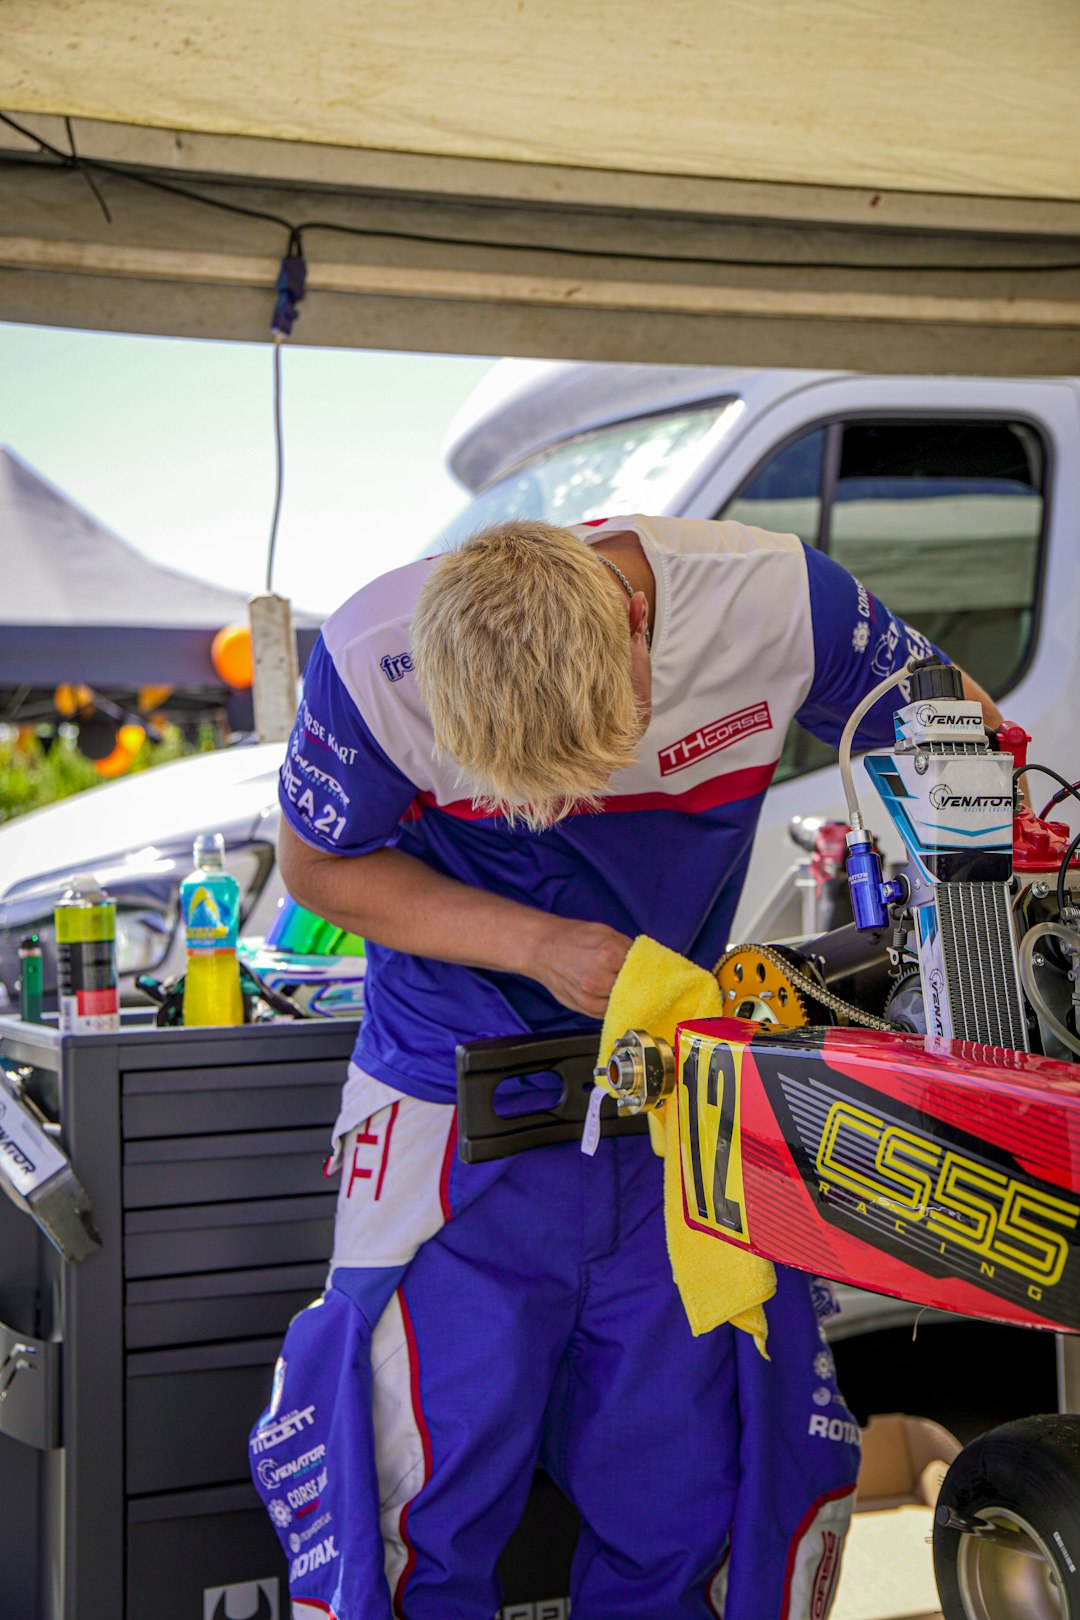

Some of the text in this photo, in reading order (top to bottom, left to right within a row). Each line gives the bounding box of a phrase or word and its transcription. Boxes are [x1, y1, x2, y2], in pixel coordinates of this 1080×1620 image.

[383, 655, 413, 680] fre
[927, 715, 982, 725] VENATO
[314, 803, 347, 840] 21
[682, 1039, 744, 1235] 12
[818, 1181, 1043, 1301] RACING
[808, 1413, 861, 1448] ROTA
[269, 1444, 326, 1483] VENATOR
[287, 1480, 319, 1509] CORSE
